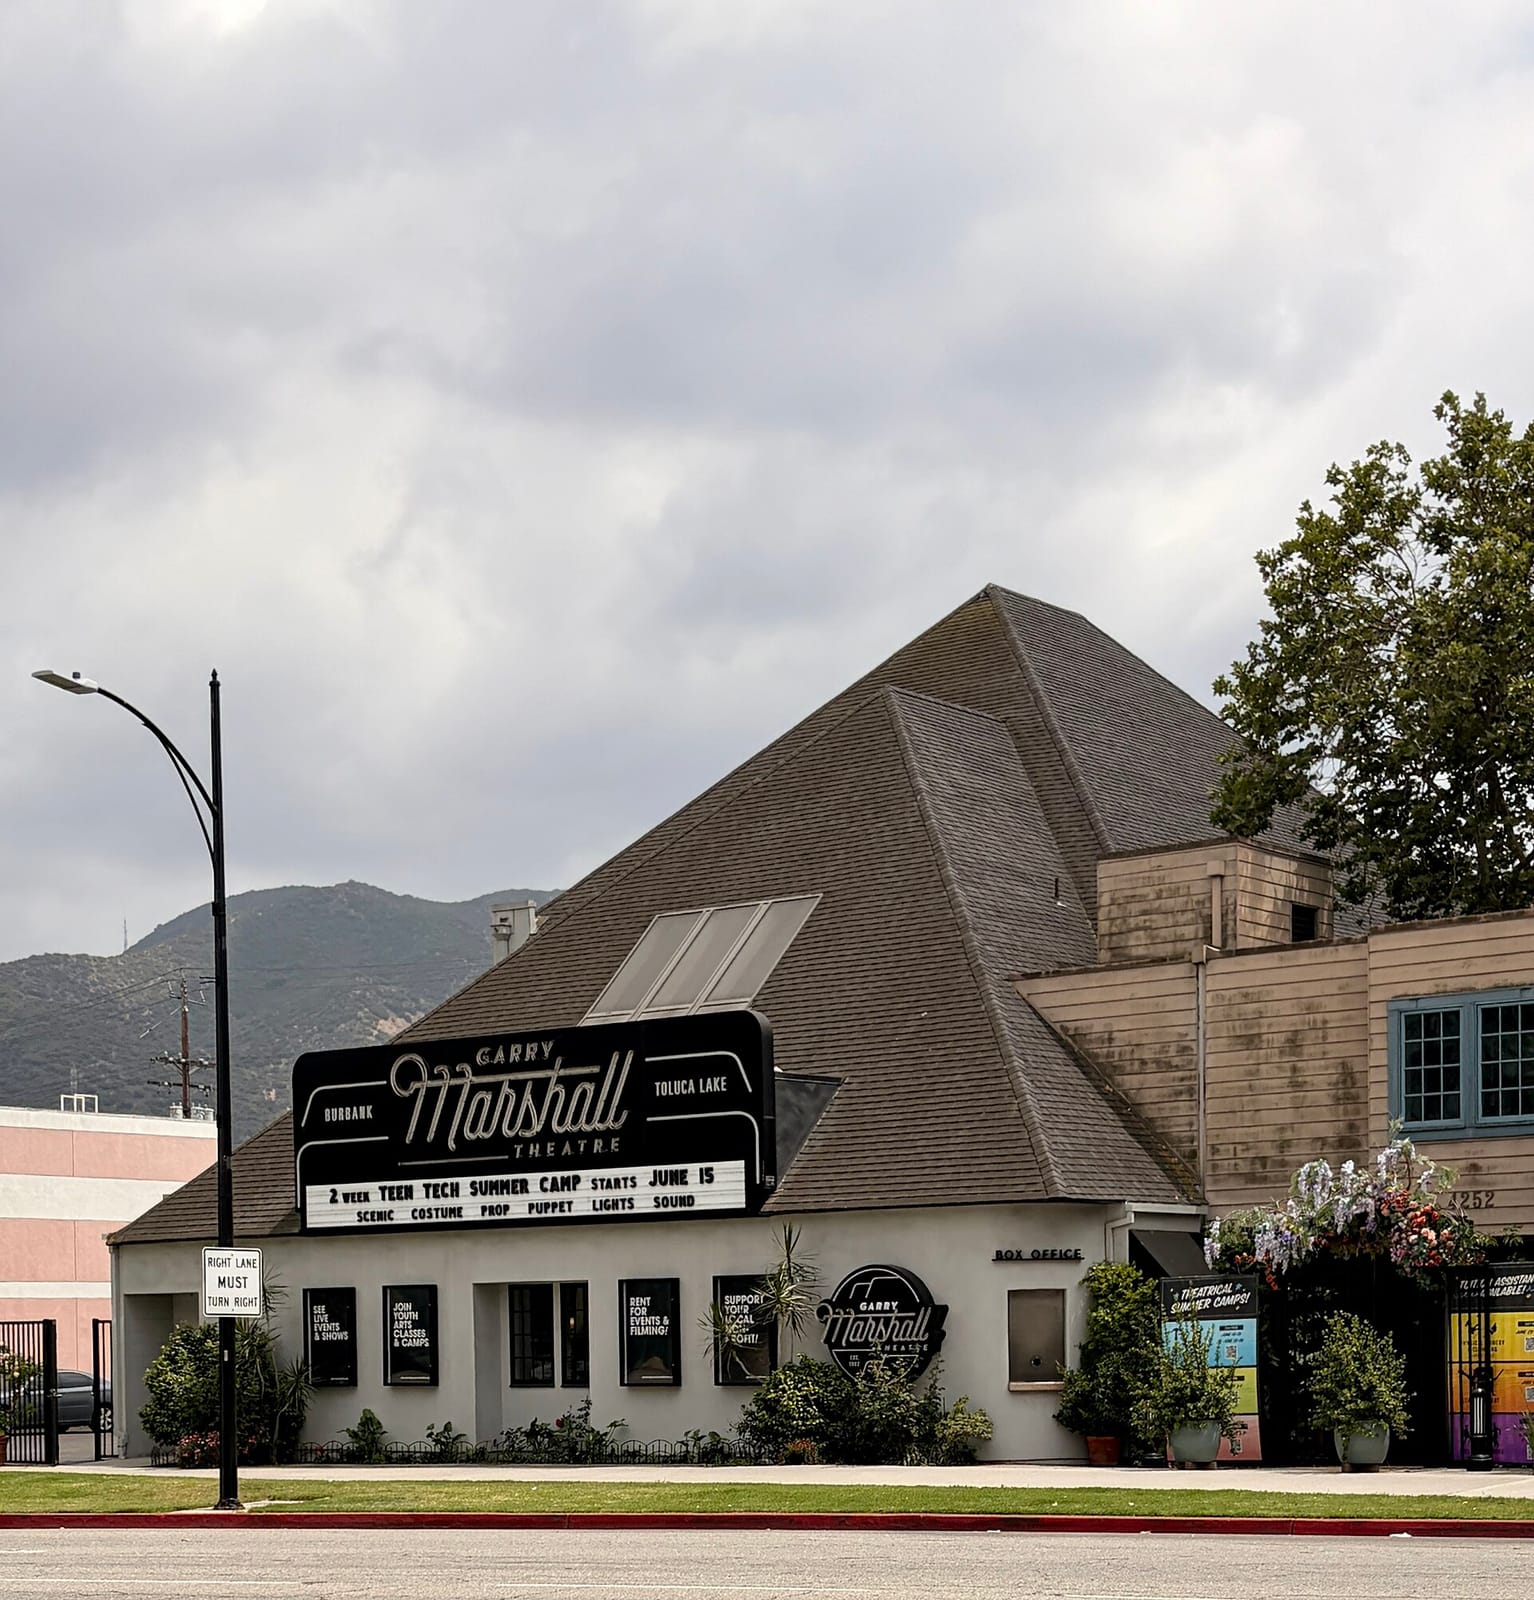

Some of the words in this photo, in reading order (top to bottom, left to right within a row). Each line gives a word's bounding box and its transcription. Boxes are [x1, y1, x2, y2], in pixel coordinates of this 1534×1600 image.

[476, 1040, 554, 1066] GARRY
[654, 1079, 695, 1097] TOLUCA
[699, 1076, 727, 1093] LAKE
[390, 1049, 634, 1151] Marshall
[324, 1104, 373, 1122] BURBANK
[514, 1137, 621, 1159] THEATRE
[329, 1188, 339, 1204] 2
[342, 1191, 370, 1203] WEEK
[378, 1184, 414, 1201] TEEN
[423, 1181, 460, 1199] TECH
[469, 1178, 529, 1197] SUMMER
[539, 1174, 582, 1193] CAMP
[591, 1176, 637, 1191] STARTS
[648, 1169, 689, 1187] JUNE
[699, 1167, 715, 1184] 15
[357, 1209, 394, 1223] SCENIC
[411, 1206, 463, 1220] COSTUME
[481, 1204, 510, 1217] PROP
[528, 1200, 574, 1215] PUPPET
[592, 1197, 635, 1212] LIGHTS
[653, 1194, 695, 1209] SOUND
[995, 1249, 1023, 1260] BOX
[1030, 1248, 1082, 1260] OFFICE
[207, 1256, 231, 1268] RIGHT
[236, 1257, 258, 1269] LANE
[217, 1275, 249, 1289] MUST
[1181, 1282, 1233, 1301] THEATRICAL
[207, 1295, 230, 1307] TURN
[234, 1296, 258, 1308] RIGHT
[629, 1296, 651, 1307] RENT
[724, 1294, 764, 1305] SUPPORT
[1213, 1291, 1251, 1308] CAMPS!
[313, 1305, 326, 1314] SEE
[393, 1302, 412, 1312] JOIN
[629, 1306, 647, 1316] FOR
[724, 1304, 749, 1315] YOUR
[859, 1301, 899, 1311] GARRY
[314, 1314, 329, 1323] LIVE
[393, 1311, 418, 1321] YOUTH
[629, 1316, 660, 1326] EVENTS
[662, 1315, 670, 1326] &
[314, 1322, 340, 1332] EVENTS
[393, 1320, 412, 1329] ARTS
[816, 1303, 931, 1347] Marshall
[314, 1332, 320, 1341] &
[322, 1331, 349, 1341] SHOWS
[393, 1329, 426, 1338] CLASSES
[629, 1326, 669, 1336] FILMING!
[393, 1338, 400, 1348] &
[401, 1338, 430, 1347] CAMPS
